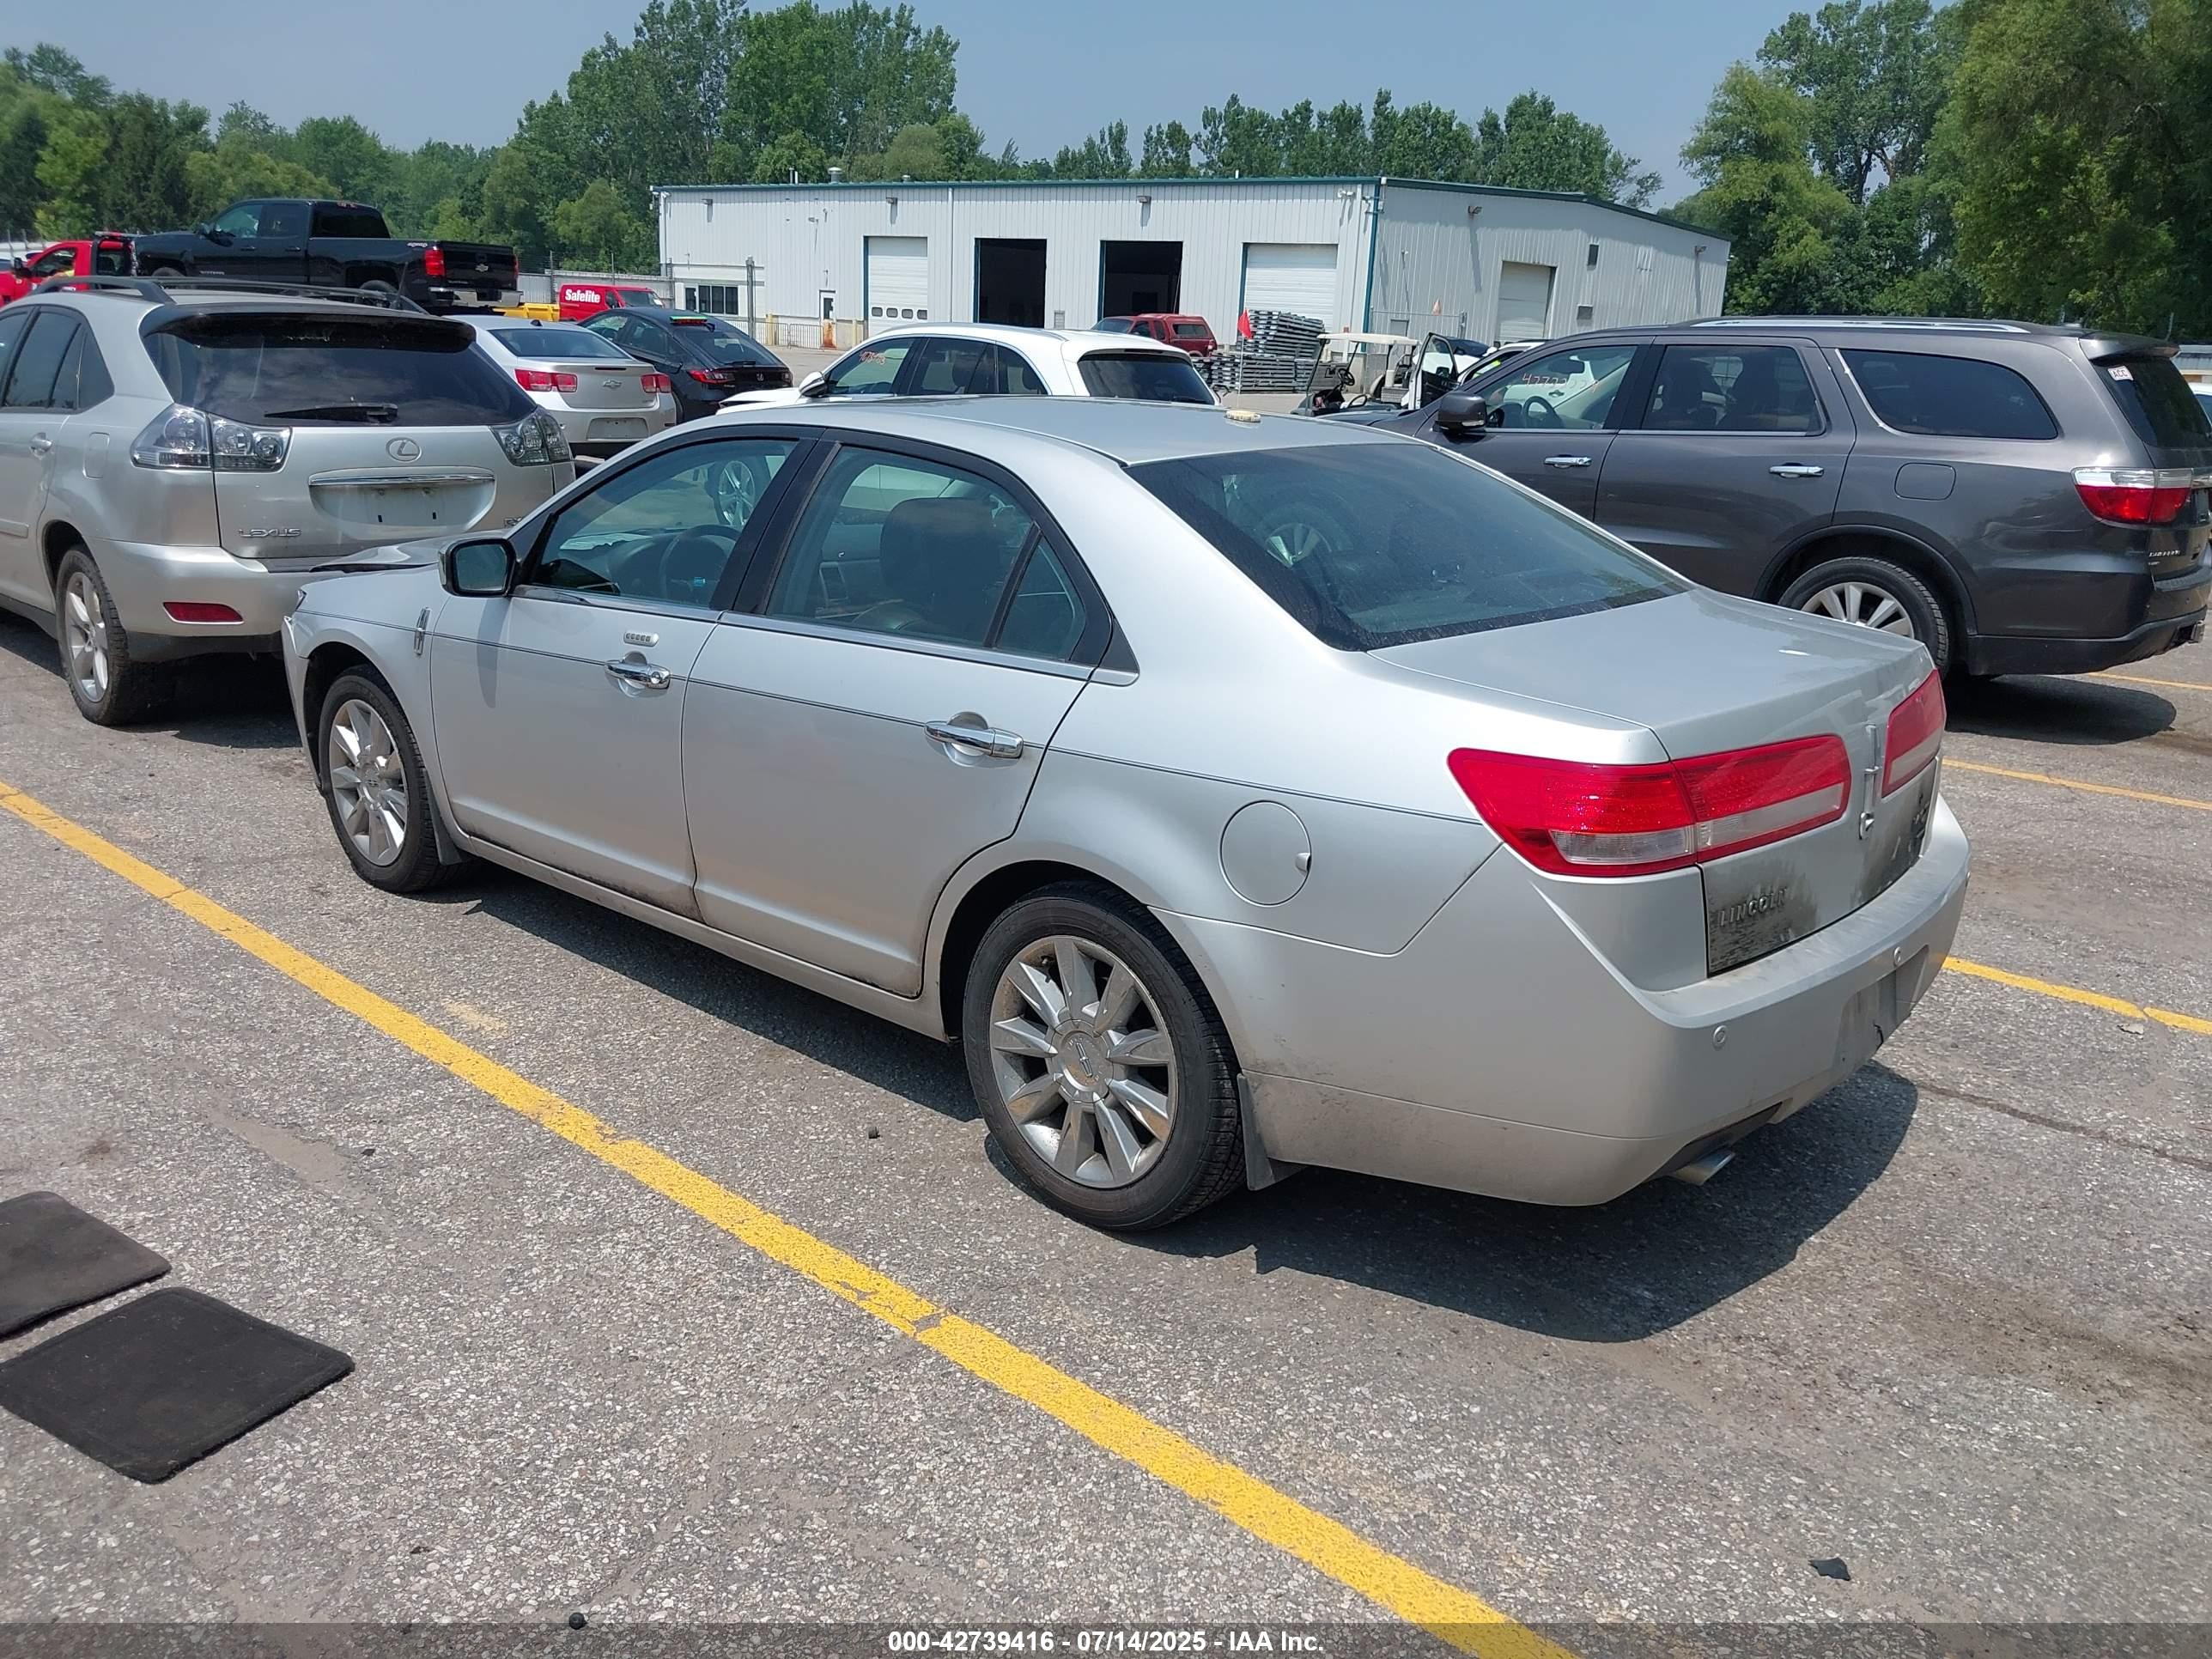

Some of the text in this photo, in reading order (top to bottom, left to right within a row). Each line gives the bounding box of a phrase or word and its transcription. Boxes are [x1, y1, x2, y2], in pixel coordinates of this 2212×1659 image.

[565, 289, 600, 303] Safelite
[238, 528, 302, 538] LEXUS
[1719, 888, 1788, 927] LINCOLN
